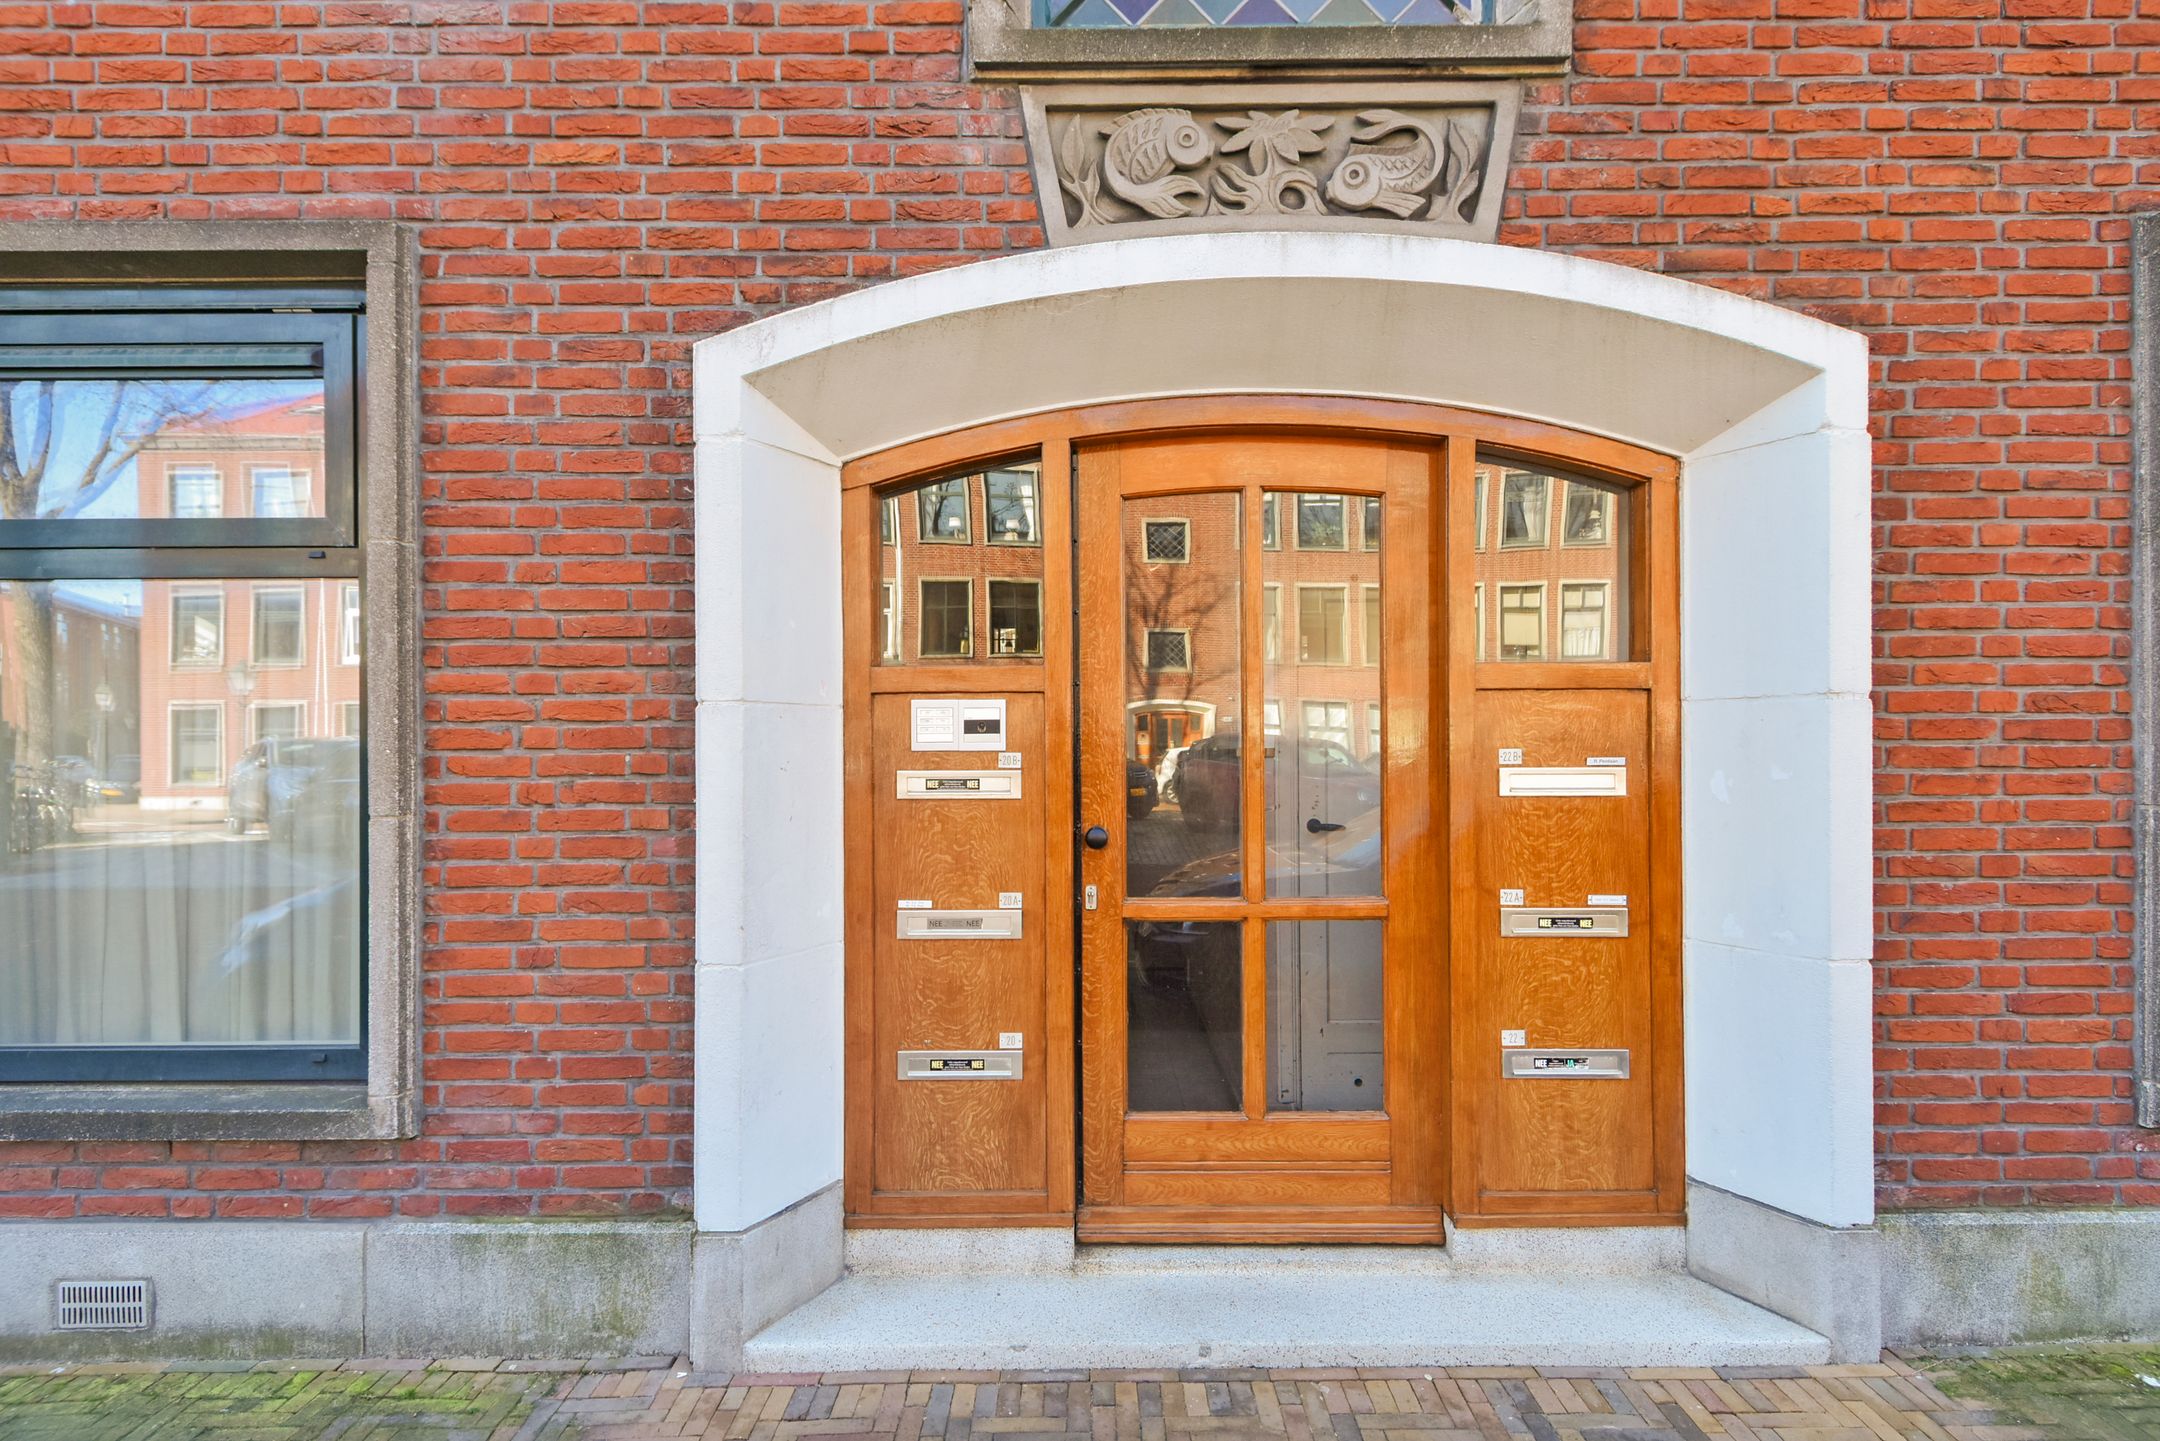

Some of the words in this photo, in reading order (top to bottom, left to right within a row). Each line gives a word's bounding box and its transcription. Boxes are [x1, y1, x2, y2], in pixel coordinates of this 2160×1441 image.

[927, 780, 940, 789] NEE
[966, 780, 979, 789] NEE
[929, 920, 943, 928] NEE
[966, 920, 980, 928] NEE
[1539, 919, 1552, 927] NEE
[1580, 919, 1592, 928] NEE
[1006, 1035, 1016, 1046] 20
[1509, 1033, 1518, 1043] 22
[931, 1060, 944, 1069] NEE
[971, 1060, 984, 1069] NEE
[1535, 1059, 1548, 1068] NEE
